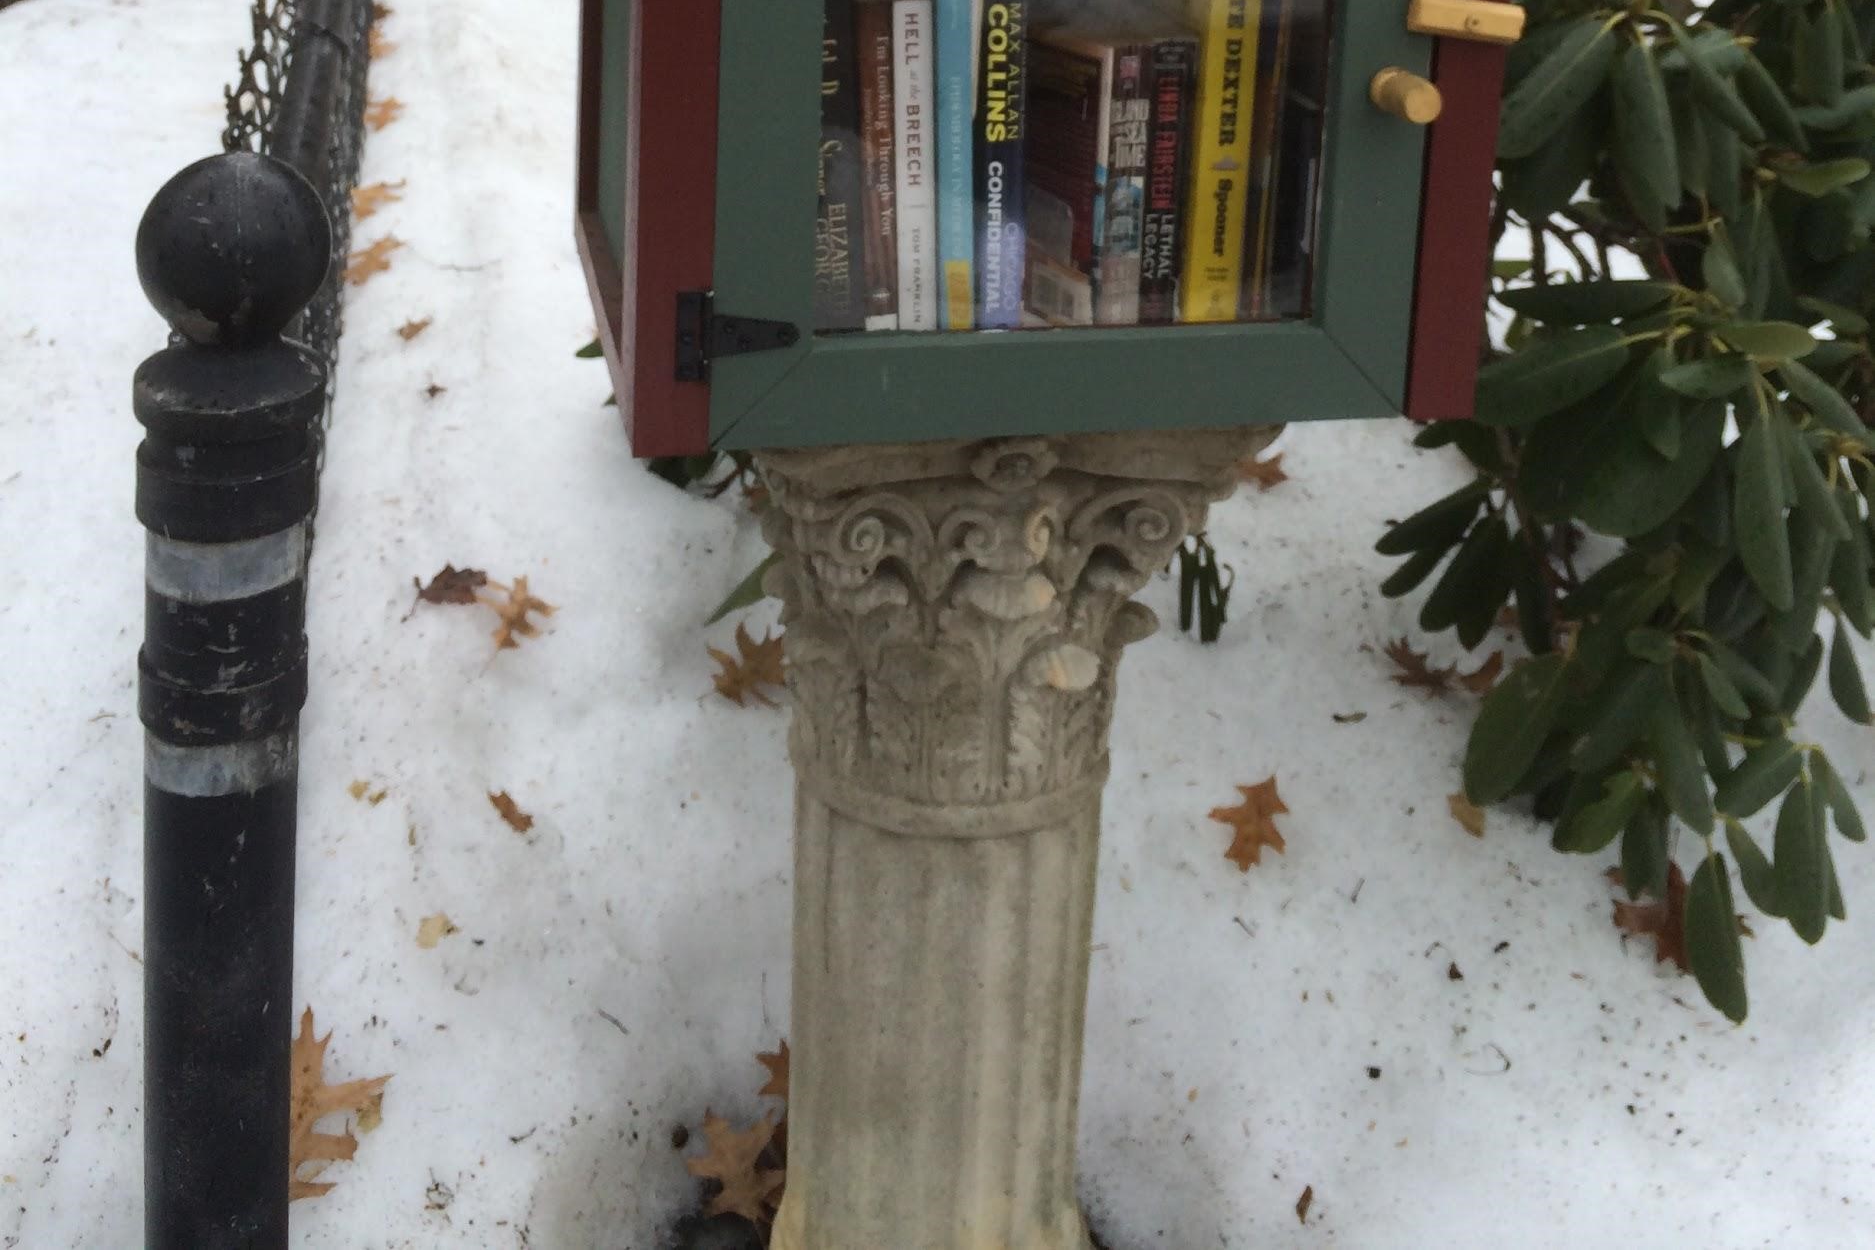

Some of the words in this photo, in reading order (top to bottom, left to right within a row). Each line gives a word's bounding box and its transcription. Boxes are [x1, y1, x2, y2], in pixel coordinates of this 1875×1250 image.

[876, 36, 890, 59] I'm
[904, 12, 920, 65] HELL
[1007, 2, 1023, 54] MAX
[873, 66, 891, 130] Looking
[909, 84, 920, 99] the
[986, 3, 1009, 143] COLLINS
[1006, 63, 1021, 140] ALLAN
[1157, 75, 1179, 124] LINDA
[1218, 38, 1244, 147] DEXTER
[878, 137, 892, 200] Through
[906, 104, 921, 187] BREECH
[1151, 130, 1178, 210] FAIRSTEIN
[880, 207, 893, 235] You
[912, 227, 921, 254] TOM
[986, 161, 1004, 315] CONFIDENTIAL
[1143, 213, 1160, 279] LEGACY
[1157, 214, 1175, 278] LETHAL
[1212, 178, 1234, 257] Spooner
[828, 203, 850, 315] ELIZABETH
[912, 258, 922, 324] FRANKLIN
[1004, 222, 1019, 311] CHICAGO
